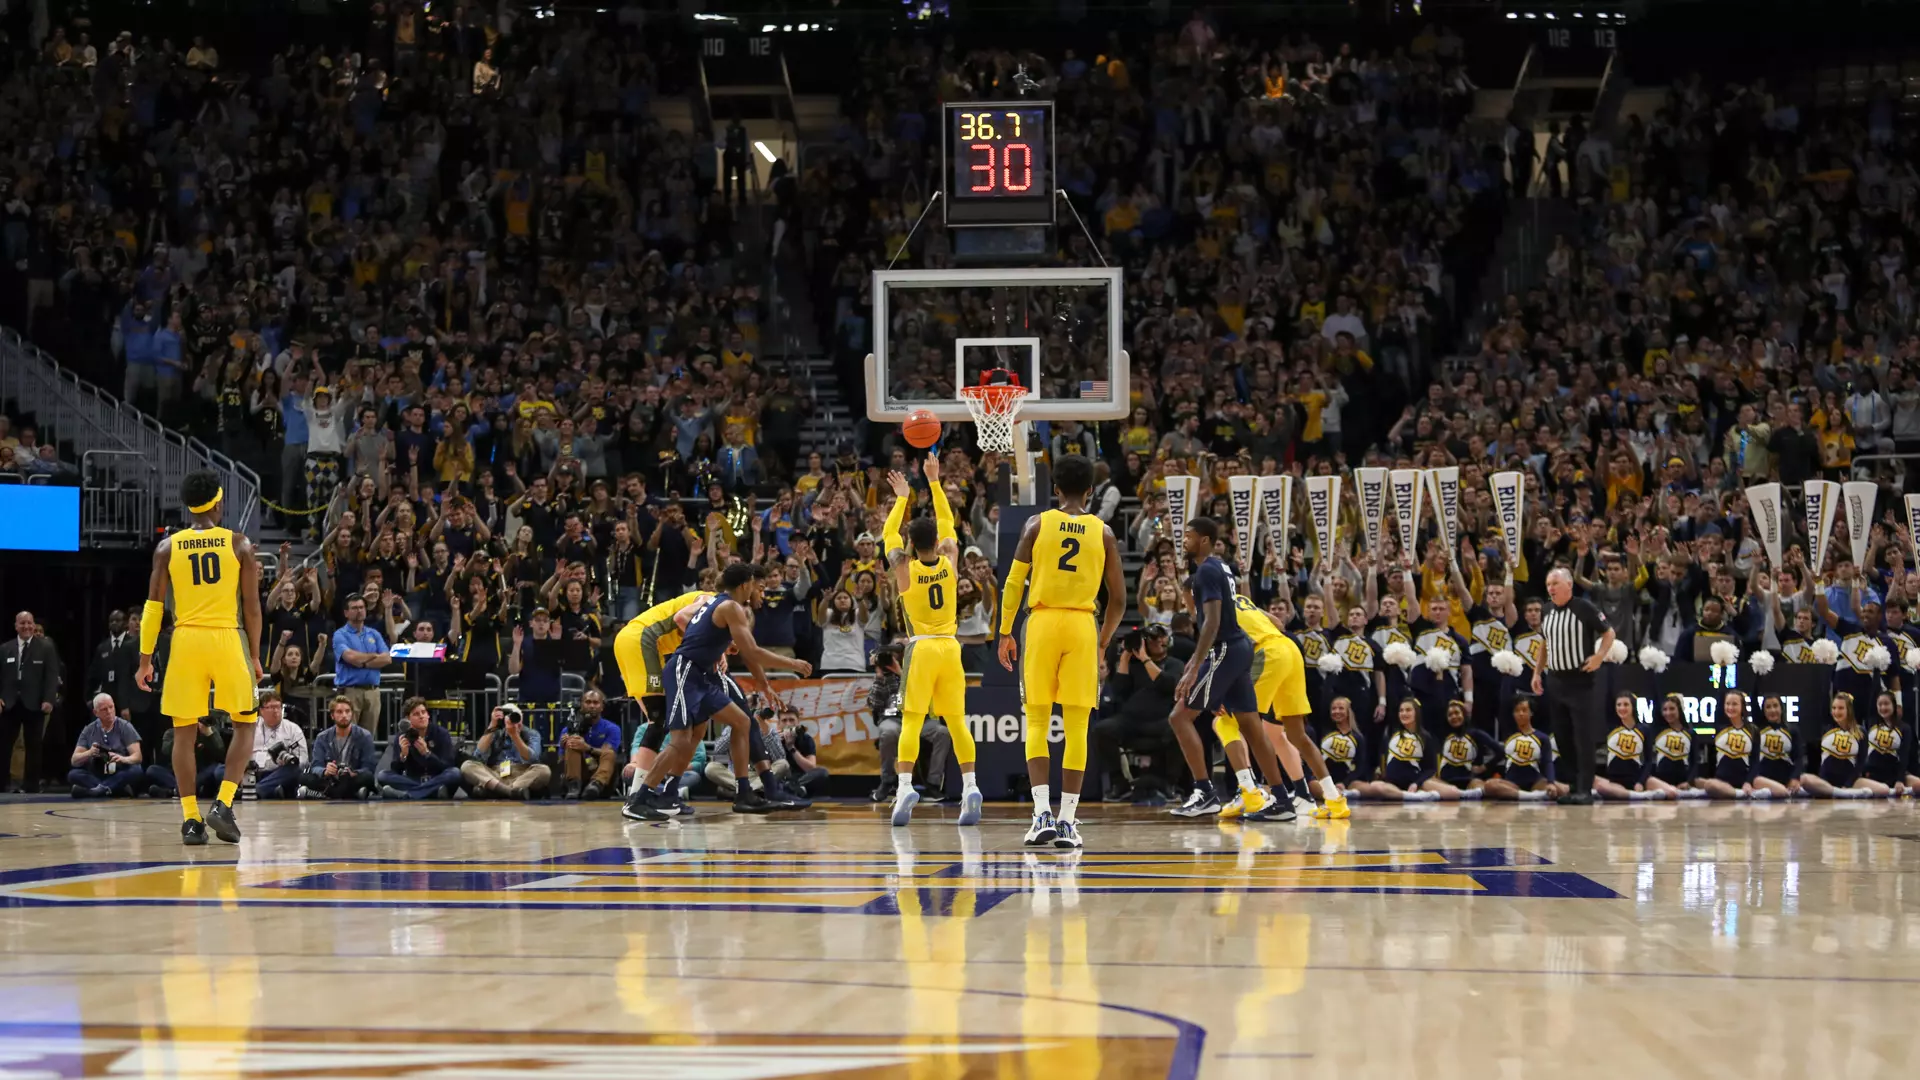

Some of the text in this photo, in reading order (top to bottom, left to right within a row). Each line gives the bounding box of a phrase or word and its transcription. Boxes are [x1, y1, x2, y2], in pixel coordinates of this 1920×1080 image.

[703, 38, 725, 56] 110
[749, 37, 771, 56] 112
[1594, 29, 1616, 48] 113
[961, 113, 1020, 140] 36.7
[971, 144, 1031, 192] 30
[1168, 489, 1184, 524] RING
[1233, 490, 1250, 527] RING
[1263, 489, 1280, 528] RING
[1310, 490, 1327, 527] RING
[1364, 482, 1381, 518] RING
[1395, 483, 1412, 520] RING
[1440, 481, 1456, 517] RING
[1498, 486, 1515, 522] RING
[1806, 494, 1820, 531] RING
[1059, 522, 1086, 535] ANIM
[177, 538, 226, 550] TORRENCE
[1058, 537, 1080, 573] 2
[188, 552, 221, 586] 10
[918, 569, 949, 584] HOWARD
[928, 583, 944, 610] 0
[1303, 636, 1322, 660] MU
[1487, 627, 1508, 652] MU
[1345, 640, 1368, 665] MU
[650, 675, 661, 688] MU
[1331, 737, 1350, 757] MU
[1449, 739, 1468, 760] MU
[1515, 739, 1535, 759] MU
[1618, 732, 1638, 754] MU
[1665, 734, 1685, 755] MU
[1727, 732, 1747, 753] MU
[1765, 734, 1784, 754] MU
[1834, 733, 1853, 753] MU
[1875, 729, 1893, 748] MU
